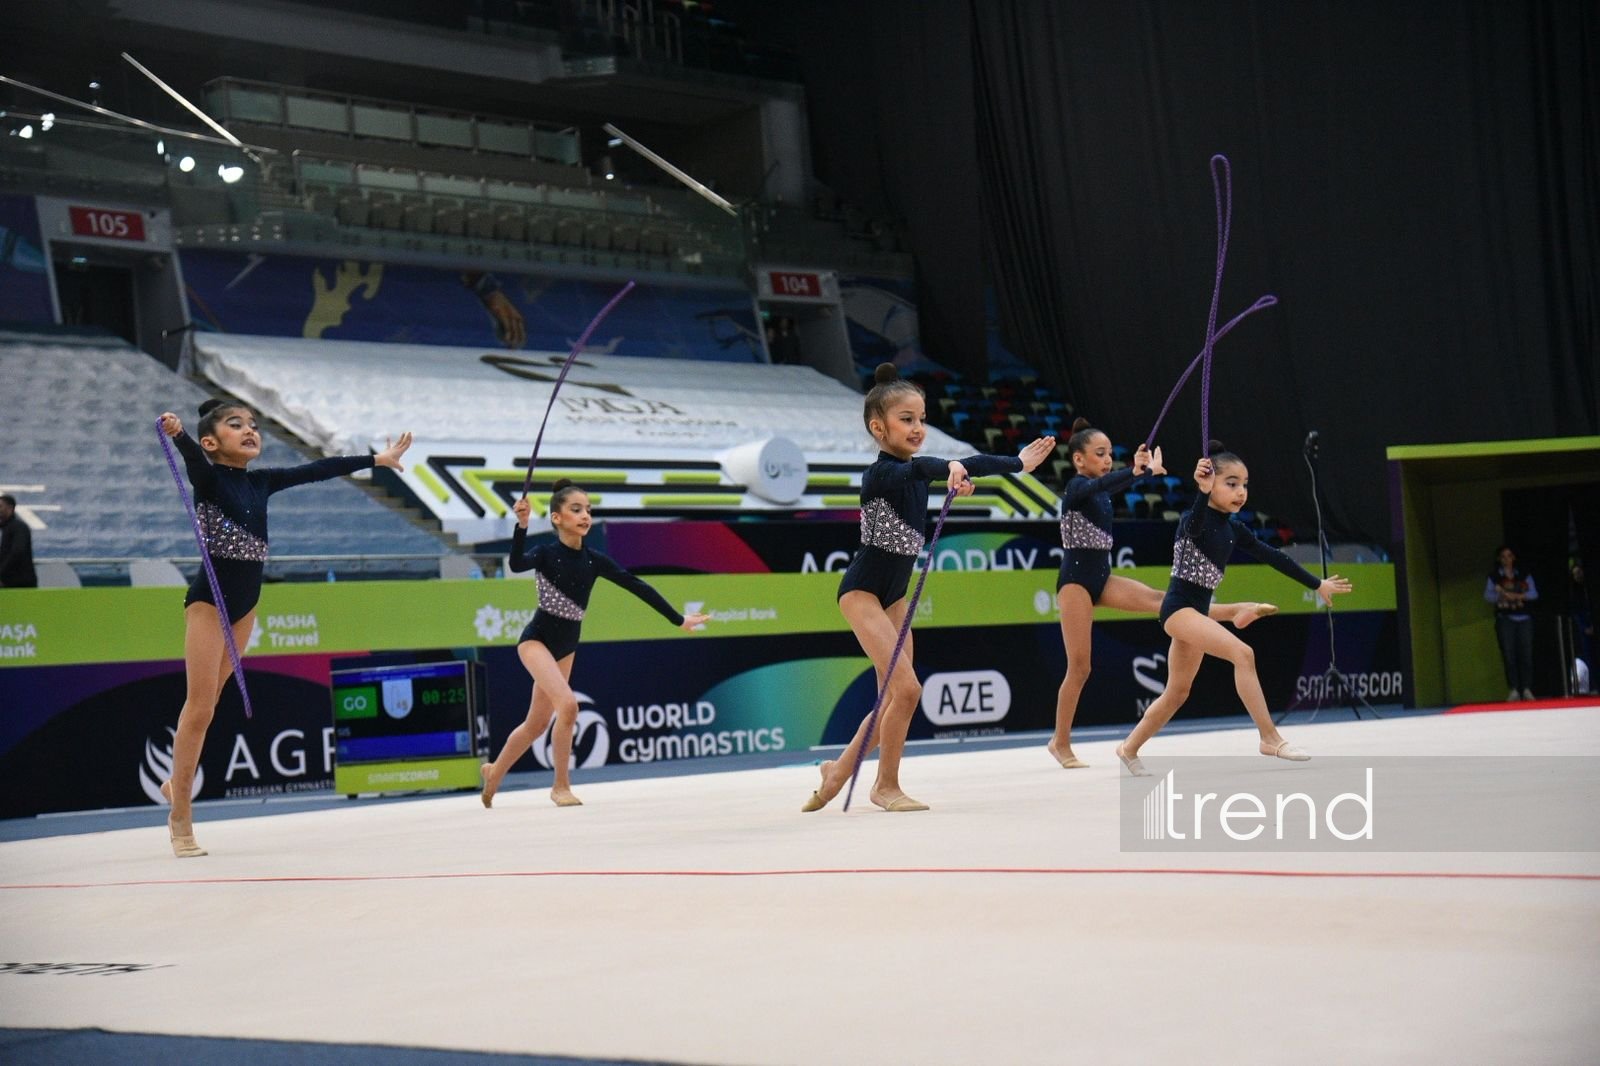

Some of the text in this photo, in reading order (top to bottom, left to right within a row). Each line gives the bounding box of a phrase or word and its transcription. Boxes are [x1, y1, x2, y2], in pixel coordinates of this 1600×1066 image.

[87, 212, 129, 236] 105
[781, 276, 810, 294] 104
[801, 550, 858, 574] AG
[914, 549, 1038, 572] OPHY
[267, 613, 317, 628] PASHA
[0, 624, 37, 644] AŞA
[270, 630, 320, 647] Travel
[0, 641, 37, 657] ank
[343, 696, 368, 711] GO
[422, 688, 466, 705] 00:25
[938, 681, 995, 715] AZE
[616, 701, 716, 731] WORLD
[618, 727, 786, 763] GYMNASTICS
